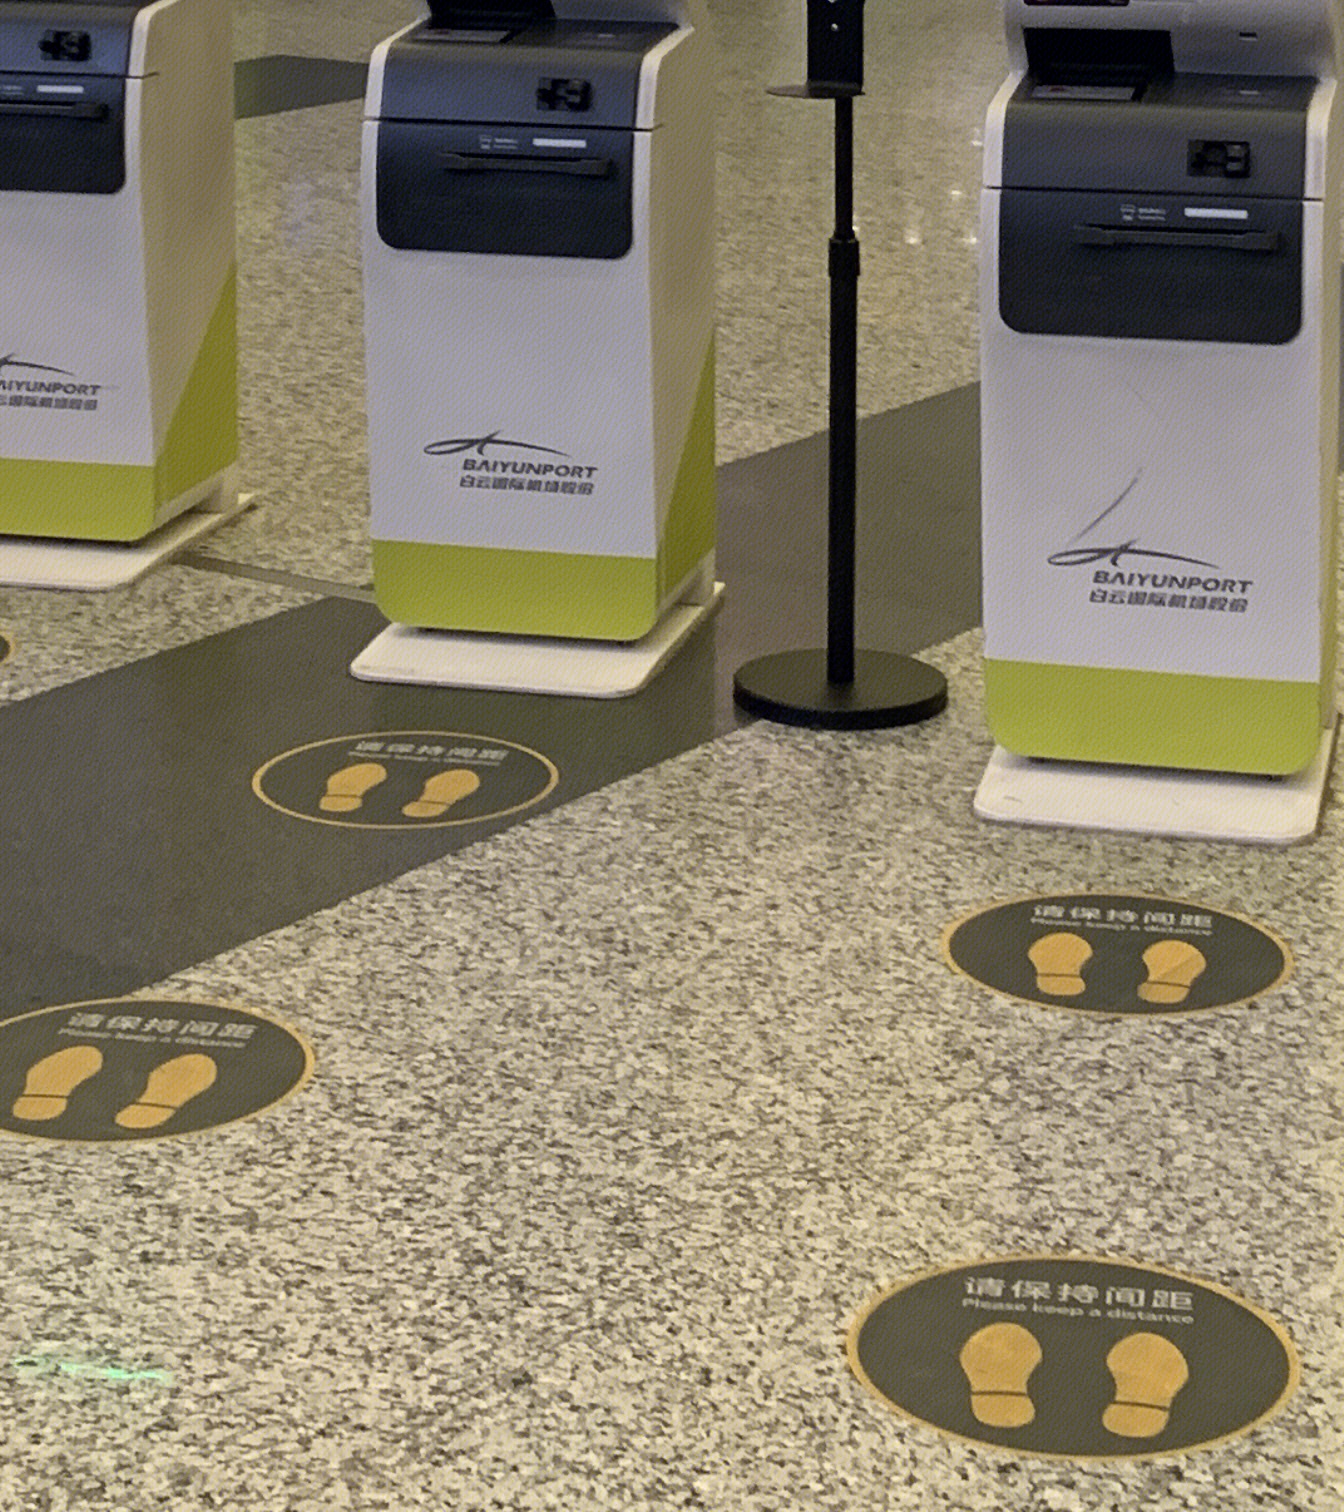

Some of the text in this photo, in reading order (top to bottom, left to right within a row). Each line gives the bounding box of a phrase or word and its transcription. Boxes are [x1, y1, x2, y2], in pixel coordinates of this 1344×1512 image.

[462, 458, 599, 479] BAIYUNPORT
[1092, 570, 1254, 593] BAIYUNPORT
[68, 1011, 259, 1040] 请保持间距
[964, 1275, 1196, 1311] 请保持间距
[962, 1296, 1028, 1315] Please
[1032, 1302, 1085, 1320] keep
[1105, 1307, 1195, 1326] distance
